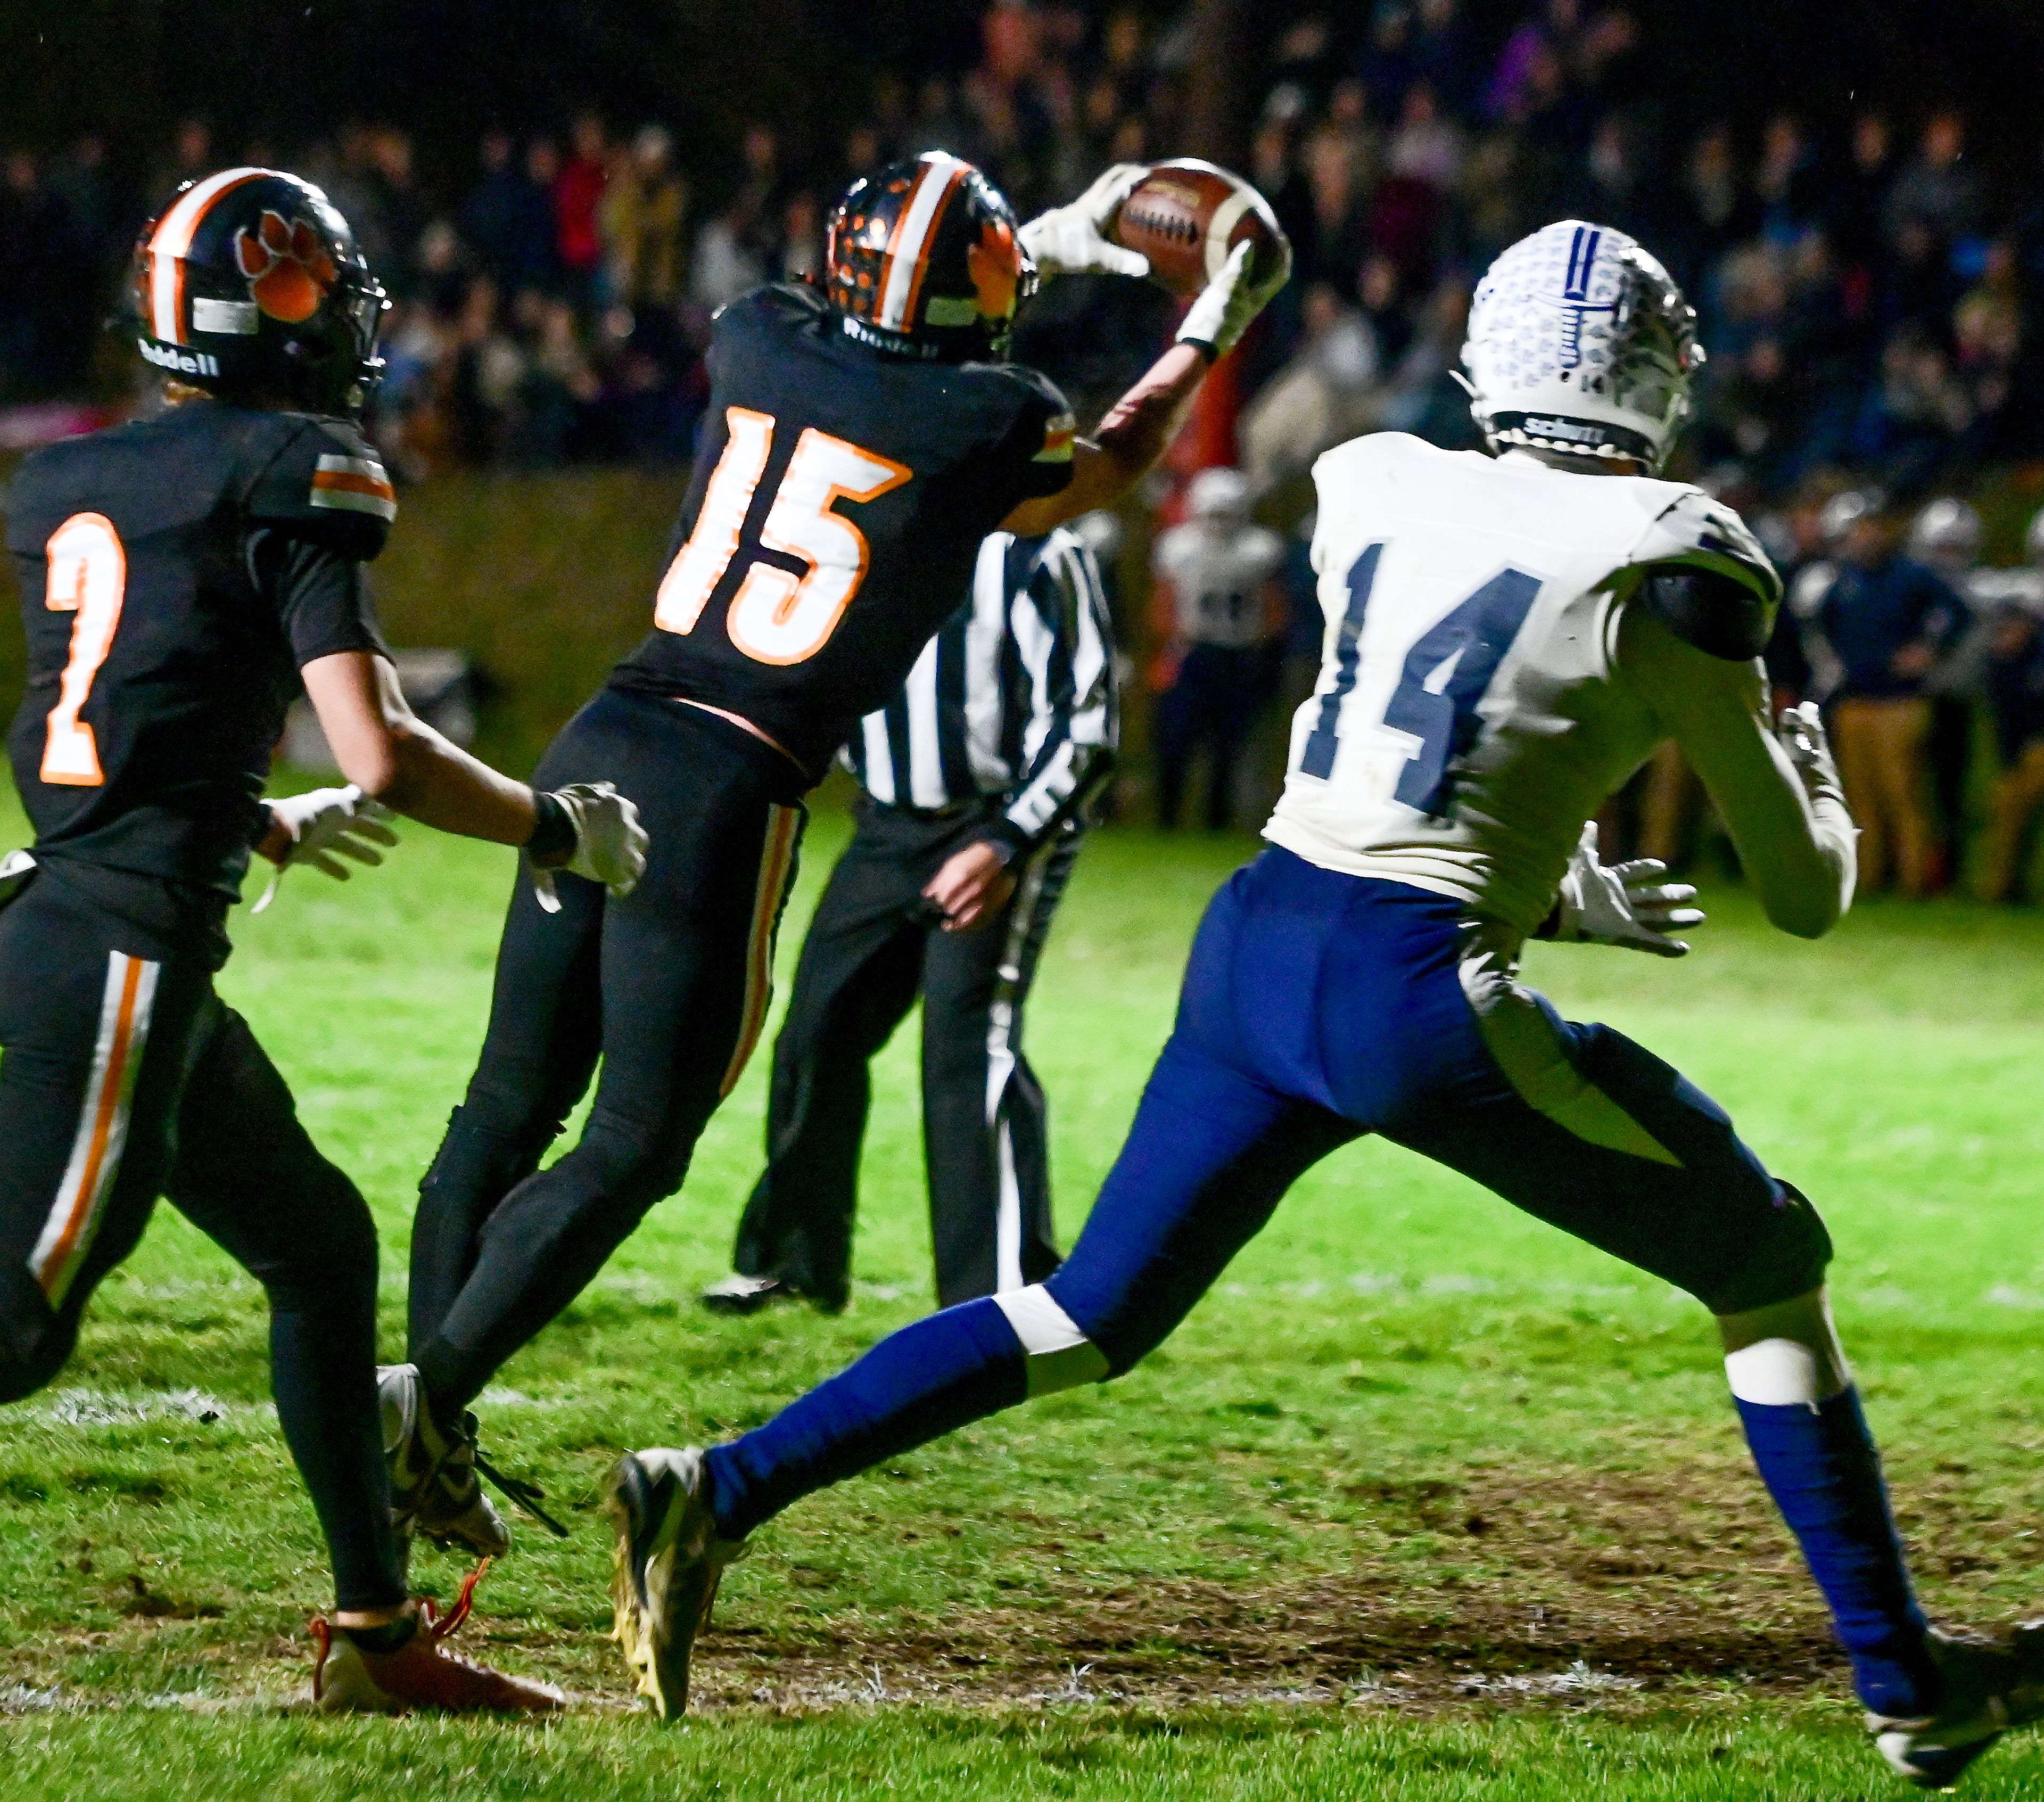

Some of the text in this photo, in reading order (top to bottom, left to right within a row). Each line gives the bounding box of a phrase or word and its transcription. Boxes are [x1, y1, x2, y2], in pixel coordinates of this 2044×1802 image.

[39, 512, 127, 786] 2
[654, 406, 913, 666] 15
[1299, 542, 1544, 818] 14
